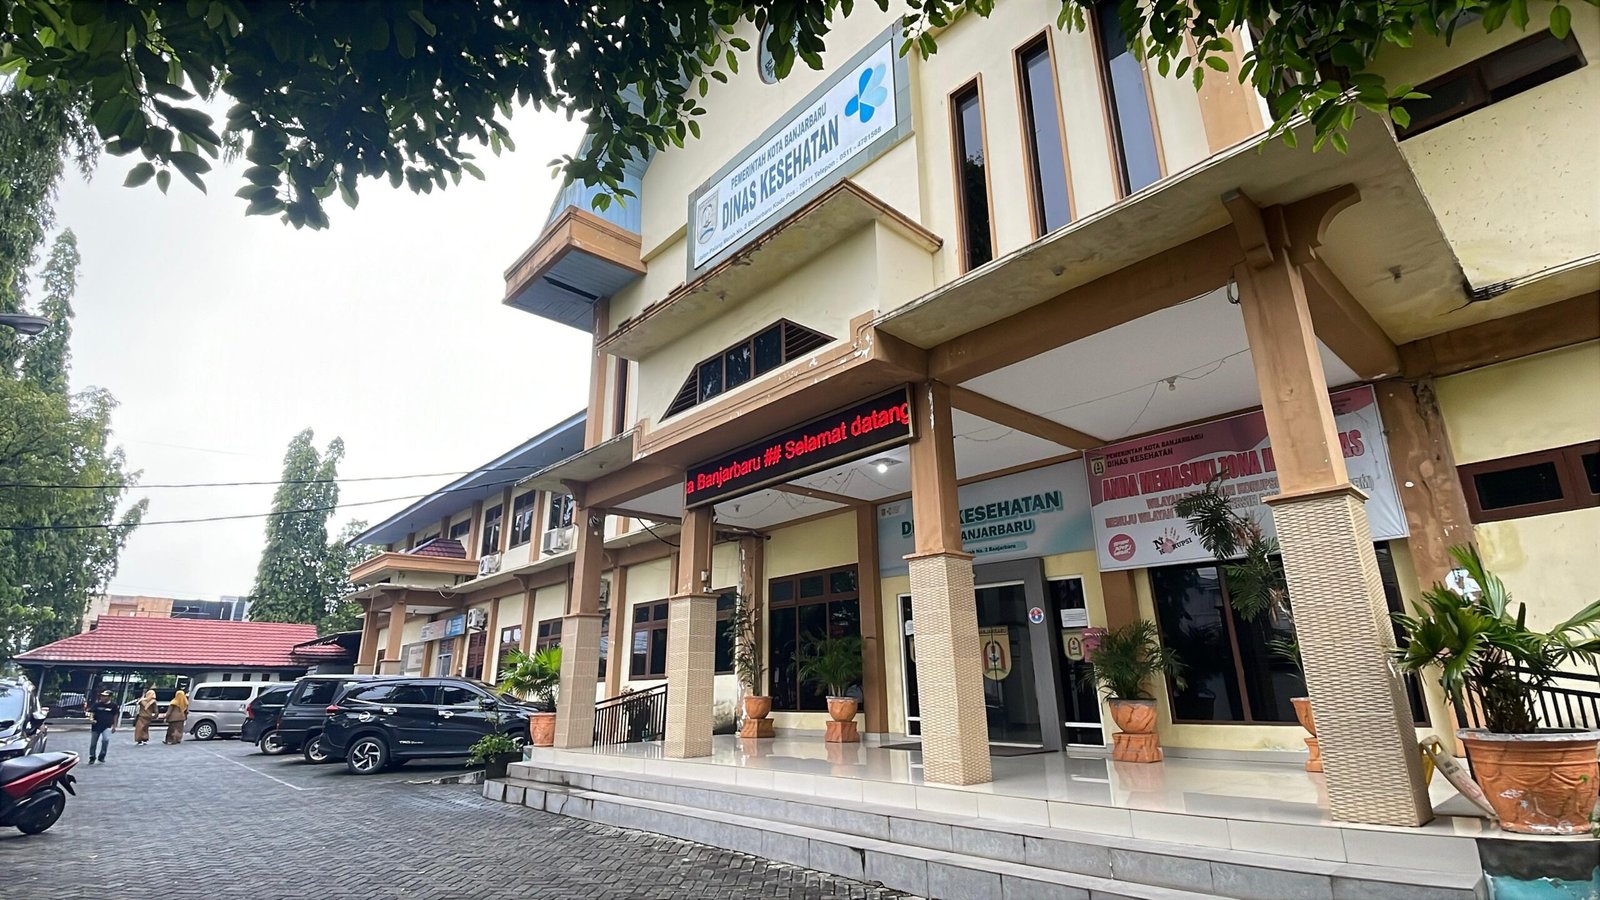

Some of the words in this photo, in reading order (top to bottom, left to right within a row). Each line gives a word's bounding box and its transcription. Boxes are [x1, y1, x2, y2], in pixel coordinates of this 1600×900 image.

[731, 153, 766, 190] PEMERINTAH
[767, 141, 783, 162] KOTA
[784, 102, 827, 147] BANJARBARU
[722, 180, 756, 230] DINAS
[760, 114, 839, 203] KESEHATAN
[815, 161, 836, 179] Telepon
[697, 456, 761, 490] Banjarbaru
[785, 422, 847, 460] Selamat
[851, 403, 909, 437] datang
[1107, 458, 1129, 468] DINAS
[1130, 448, 1174, 463] KESEHATAN
[1144, 443, 1160, 452] KOTA
[1103, 474, 1140, 501] ANDA
[1139, 459, 1218, 495] MEMASUKI
[1218, 450, 1262, 480] ZONA
[961, 519, 1034, 541] ANJARBARU
